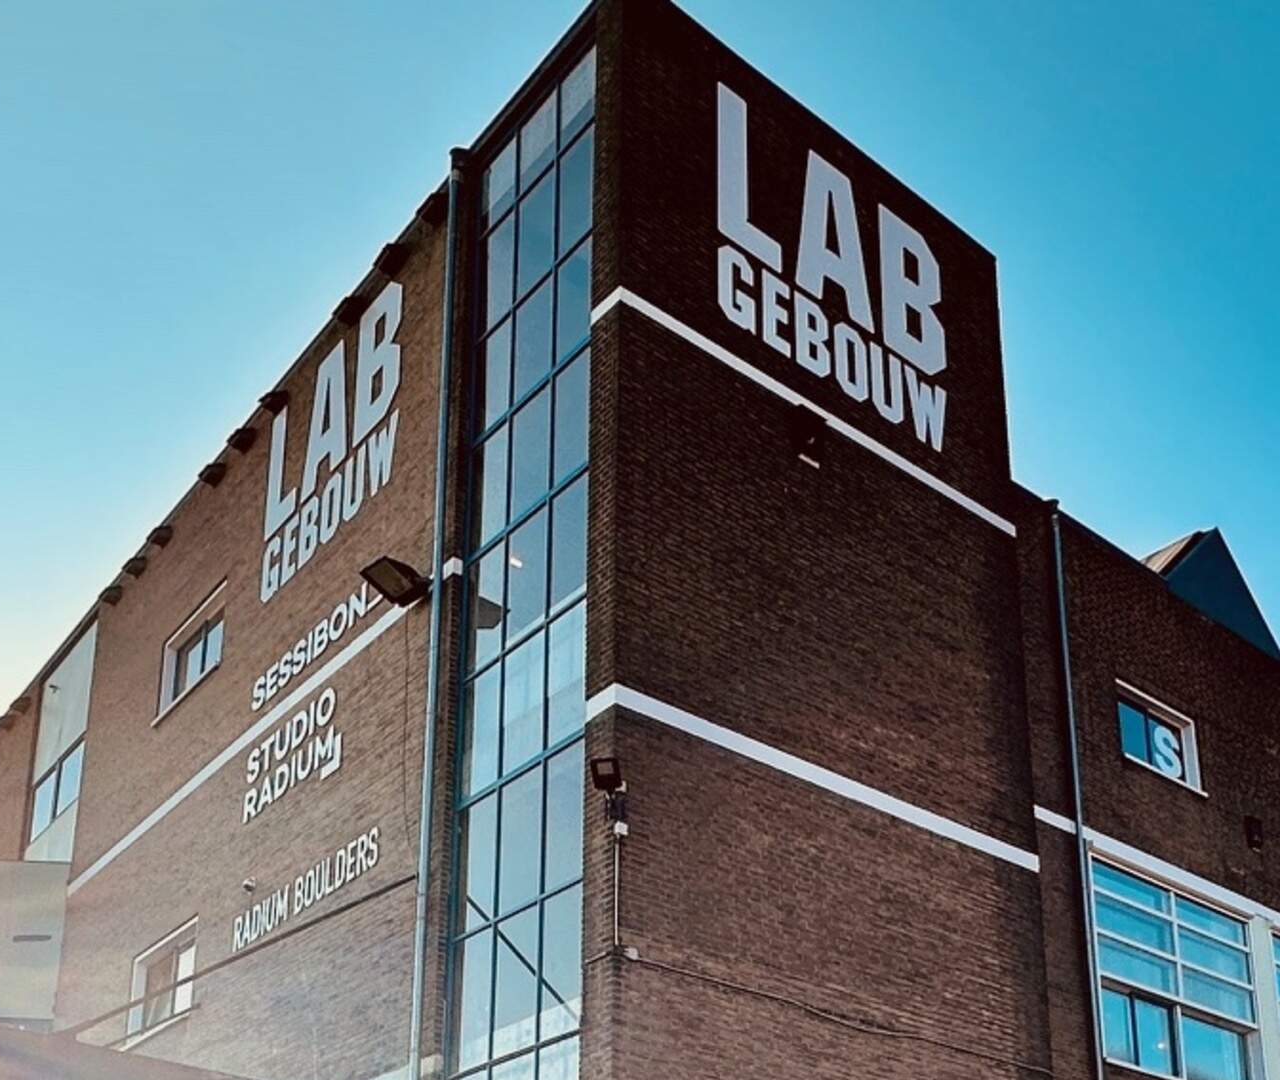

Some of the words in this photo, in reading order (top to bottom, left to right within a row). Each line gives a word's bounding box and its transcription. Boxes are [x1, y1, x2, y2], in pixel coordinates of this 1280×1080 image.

[717, 81, 947, 376] LAB
[264, 281, 403, 542] LAB
[717, 245, 947, 452] GEBOUW
[260, 409, 400, 604] GEBOUW
[242, 724, 336, 824] RADIUM
[246, 687, 336, 784] STUDIO
[232, 883, 290, 953] RADIUM
[293, 826, 380, 915] BOULDERS
